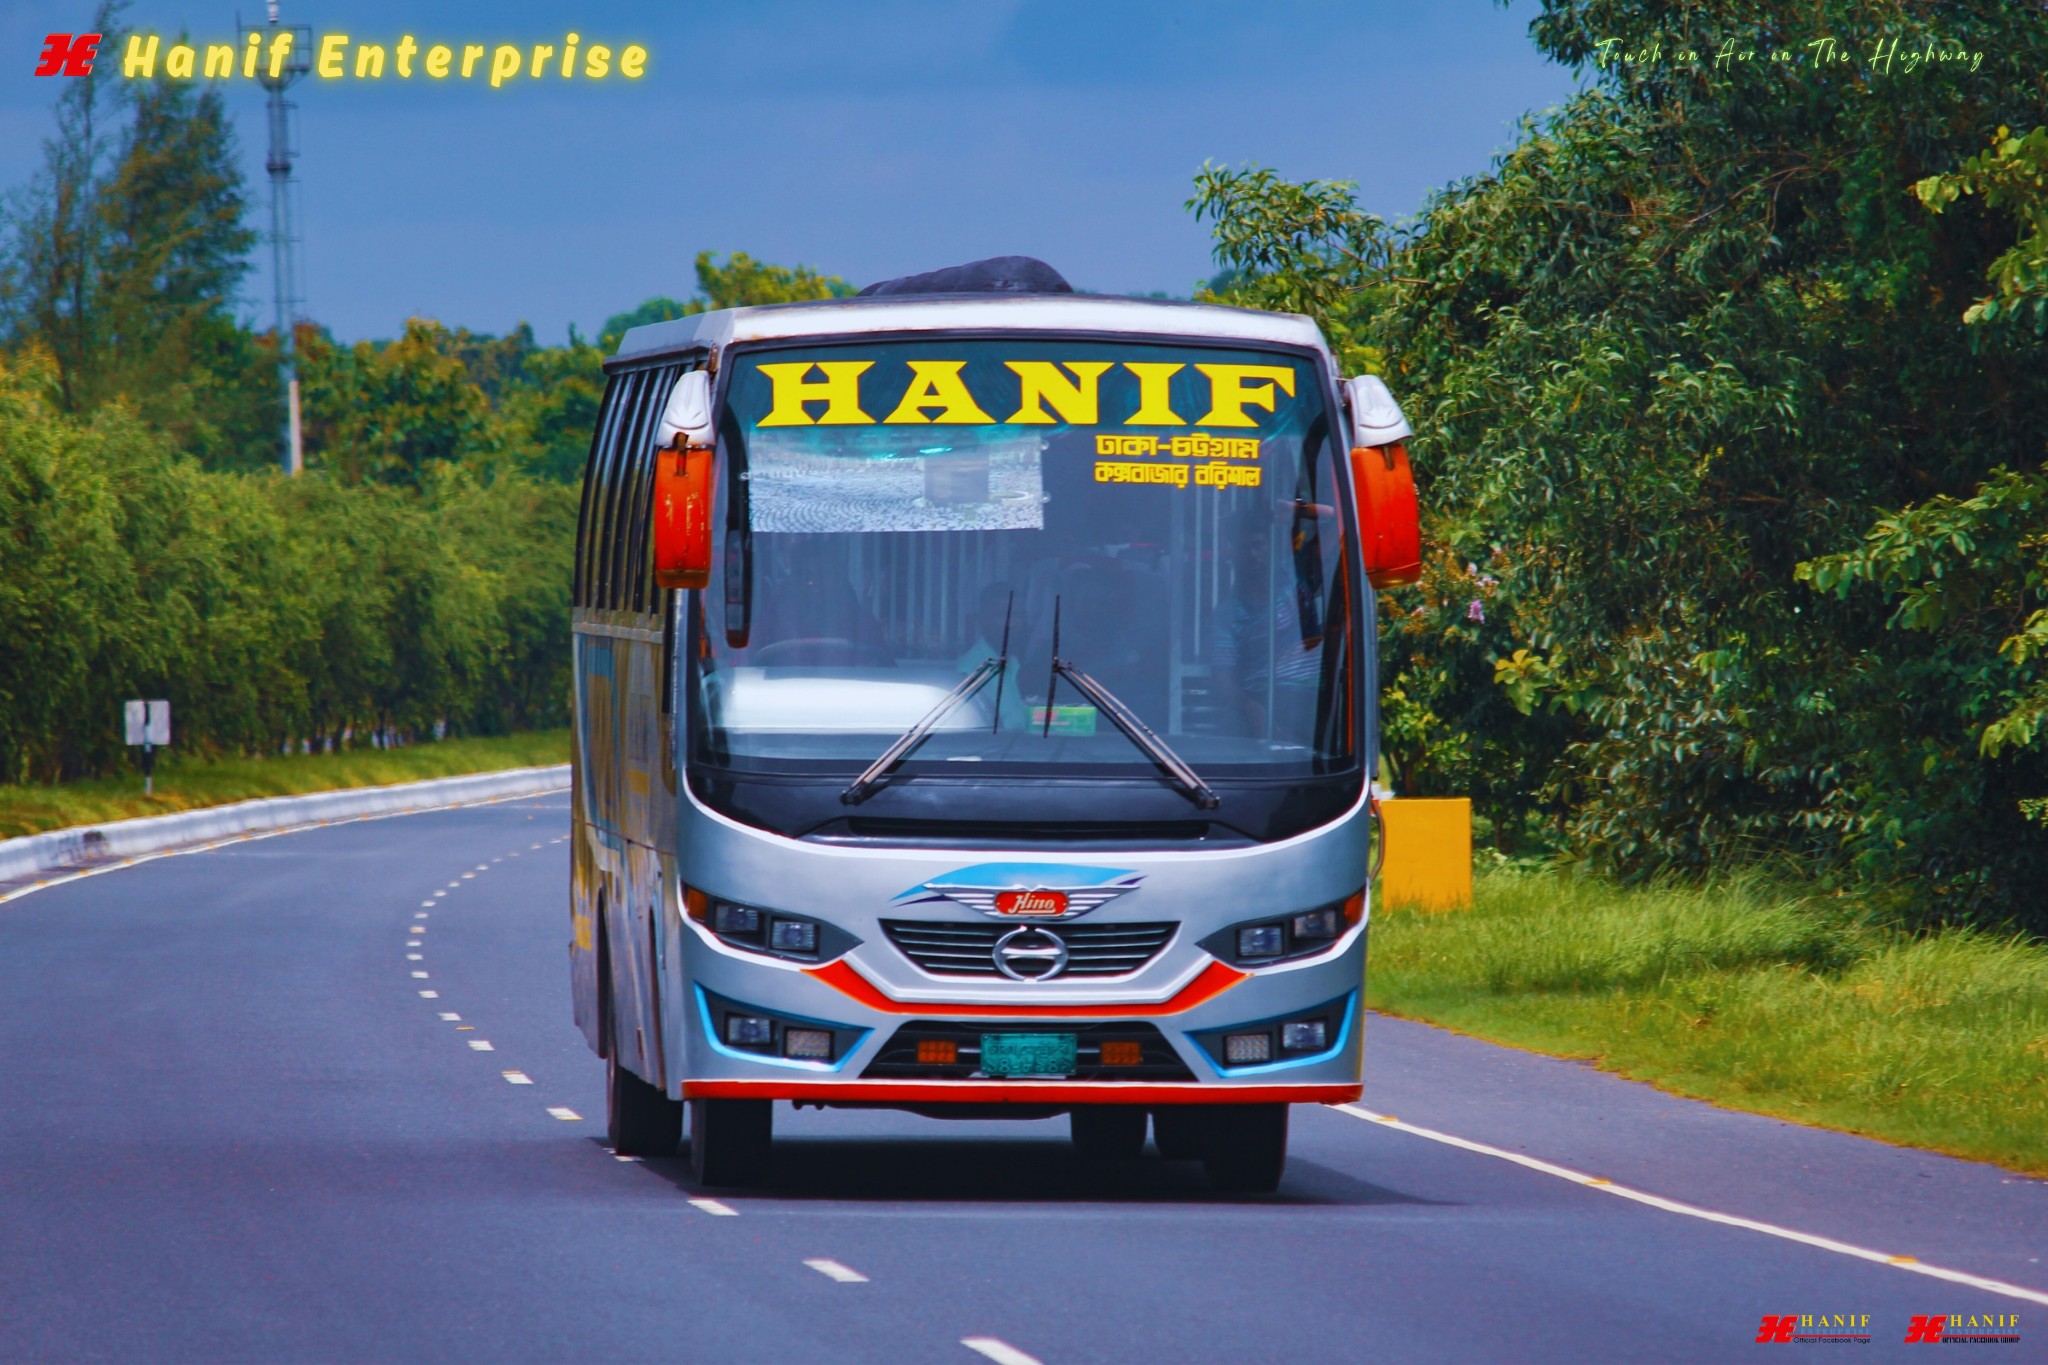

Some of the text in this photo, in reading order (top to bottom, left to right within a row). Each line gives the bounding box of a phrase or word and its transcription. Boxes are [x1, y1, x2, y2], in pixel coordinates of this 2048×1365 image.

[756, 361, 1295, 428] HANIF
[1095, 432, 1261, 459] ঢাকা-চট্টগ্রাম
[1094, 461, 1262, 490] কক্সবাজার বরিশাল
[1007, 892, 1056, 915] Hino
